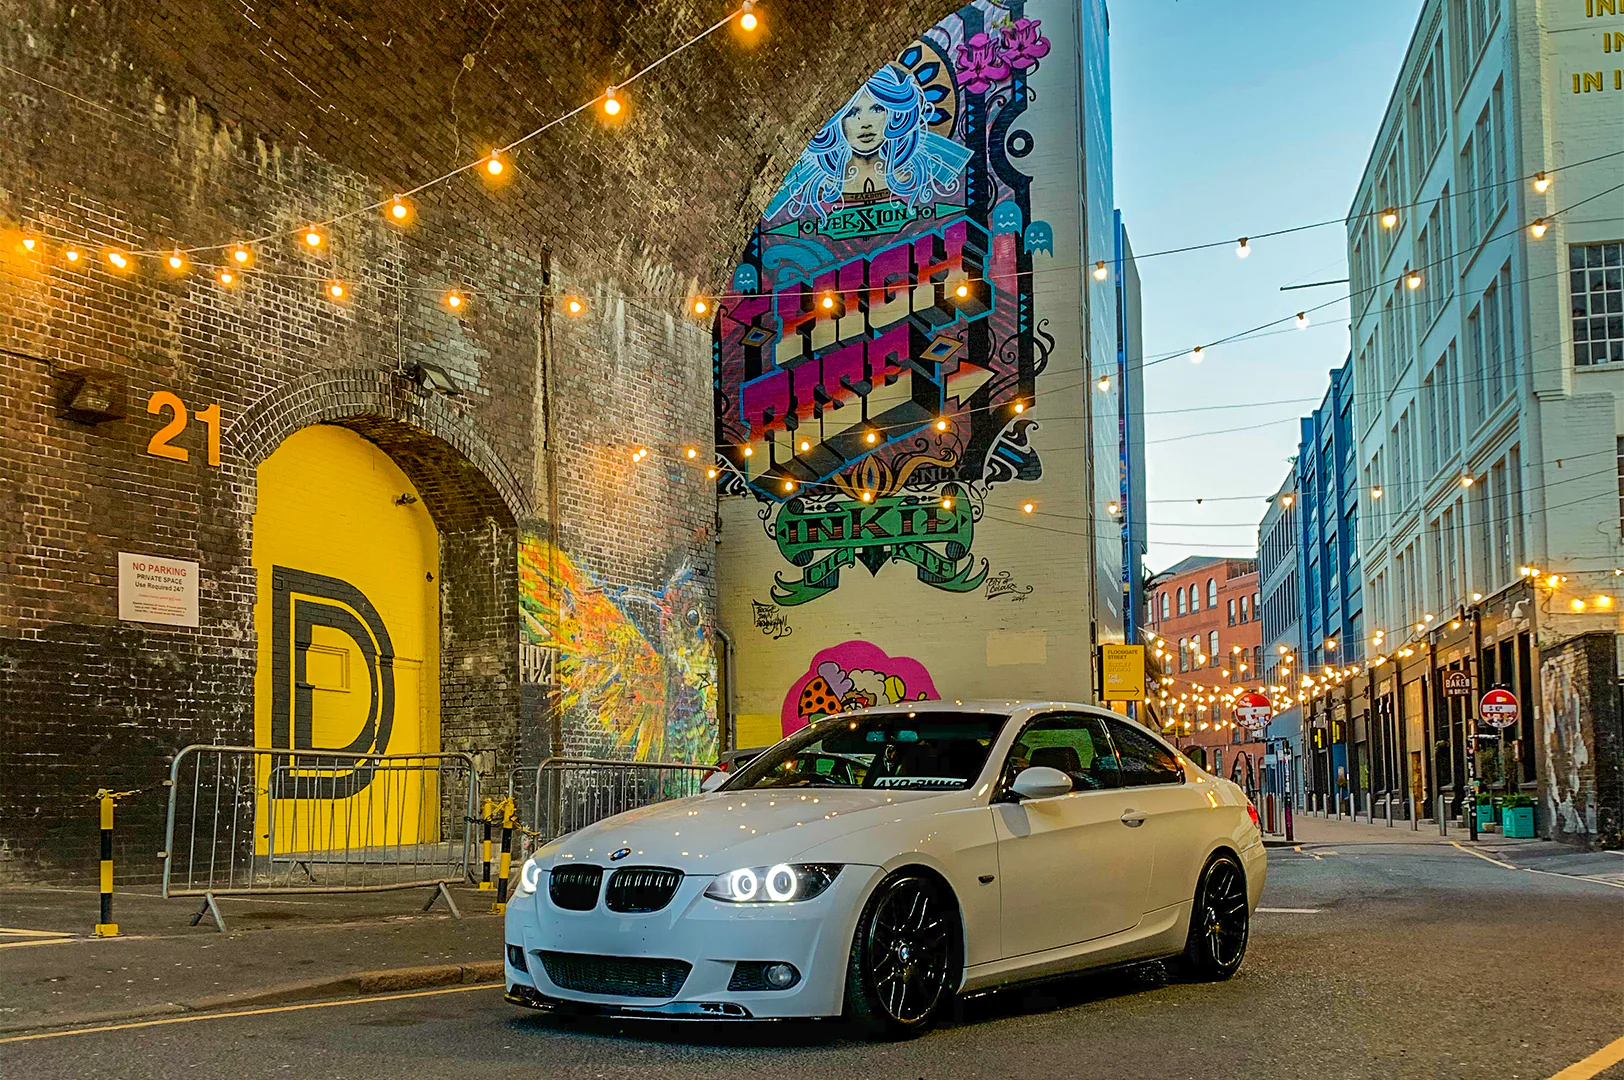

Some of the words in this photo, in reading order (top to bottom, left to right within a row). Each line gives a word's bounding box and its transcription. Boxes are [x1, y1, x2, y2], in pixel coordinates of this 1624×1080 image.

[1585, 0, 1624, 17] IN
[1572, 71, 1603, 93] IN
[774, 220, 980, 368] HIGH
[743, 321, 916, 485] RISE
[146, 390, 221, 467] 21
[907, 464, 967, 485] ENCY
[784, 502, 958, 545] INKIE
[132, 562, 146, 572] NO
[148, 563, 187, 577] PARKING
[136, 573, 161, 583] PRIVATE
[163, 576, 183, 585] SPACE
[147, 582, 172, 592] Required
[271, 564, 395, 800] D
[1445, 678, 1470, 688] BAKED
